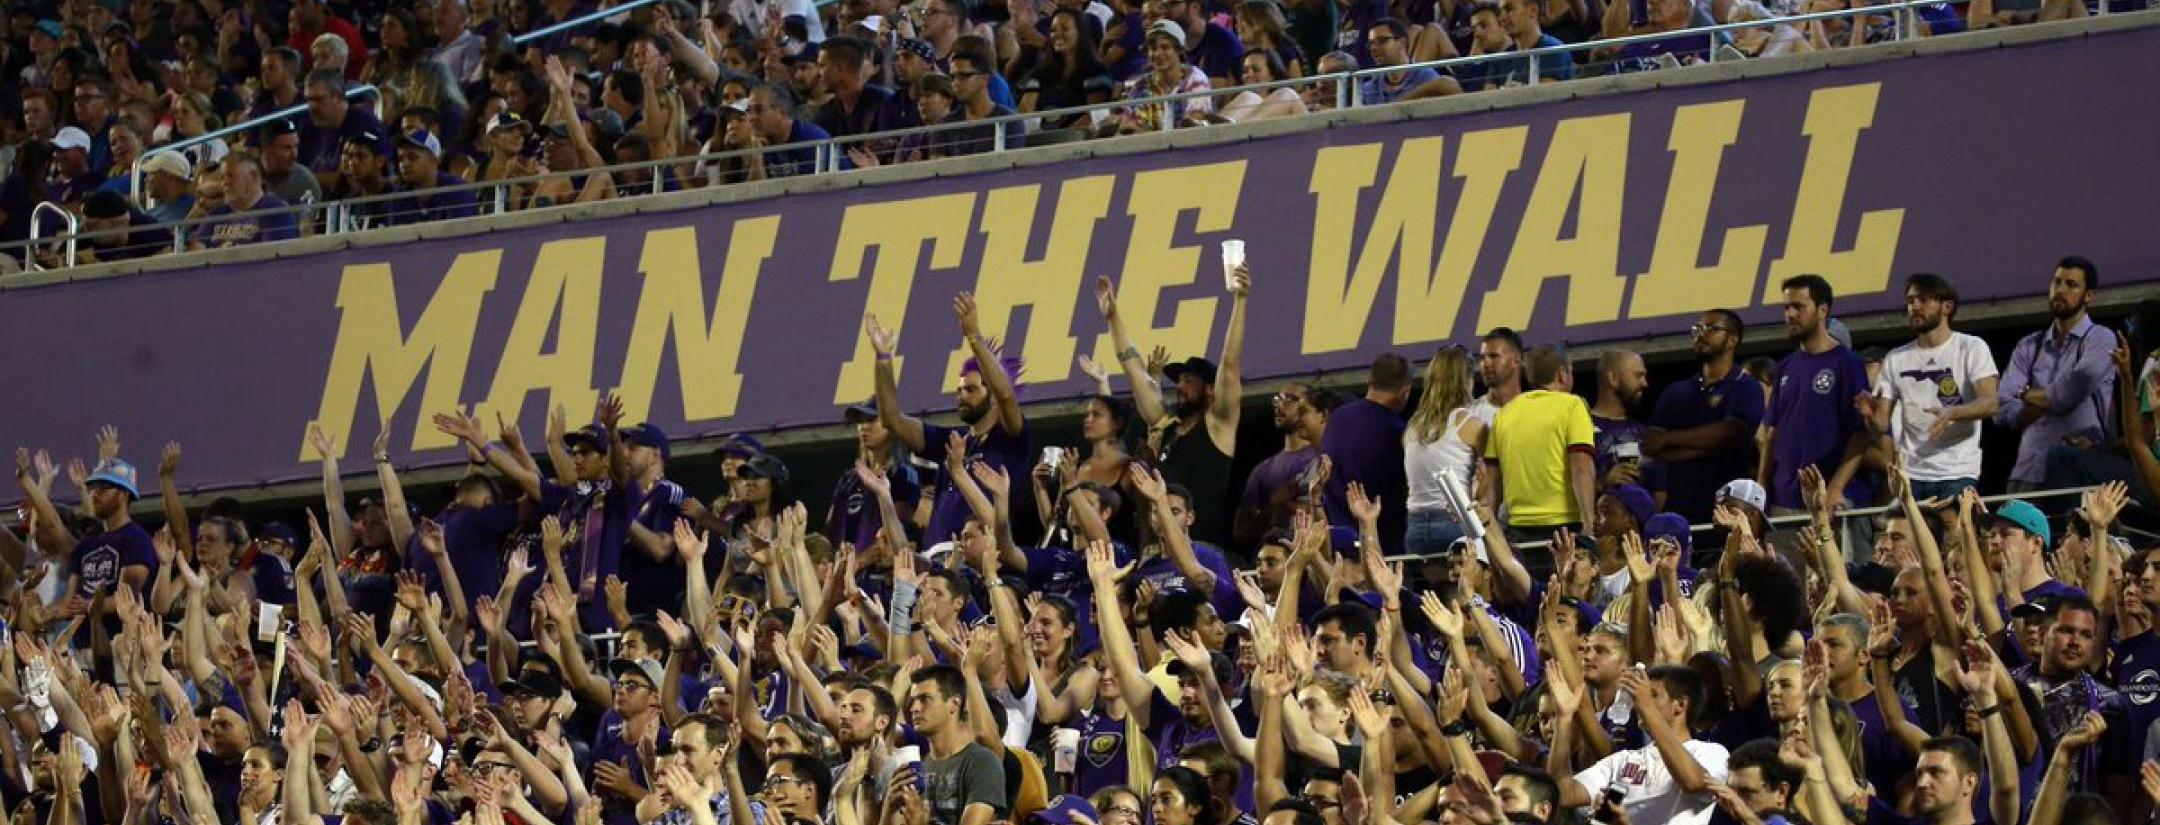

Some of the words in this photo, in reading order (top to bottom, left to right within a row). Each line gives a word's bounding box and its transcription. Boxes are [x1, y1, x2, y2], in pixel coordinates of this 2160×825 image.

[299, 217, 778, 462] MAN
[829, 160, 1248, 406] THE
[1302, 82, 1905, 355] WALL
